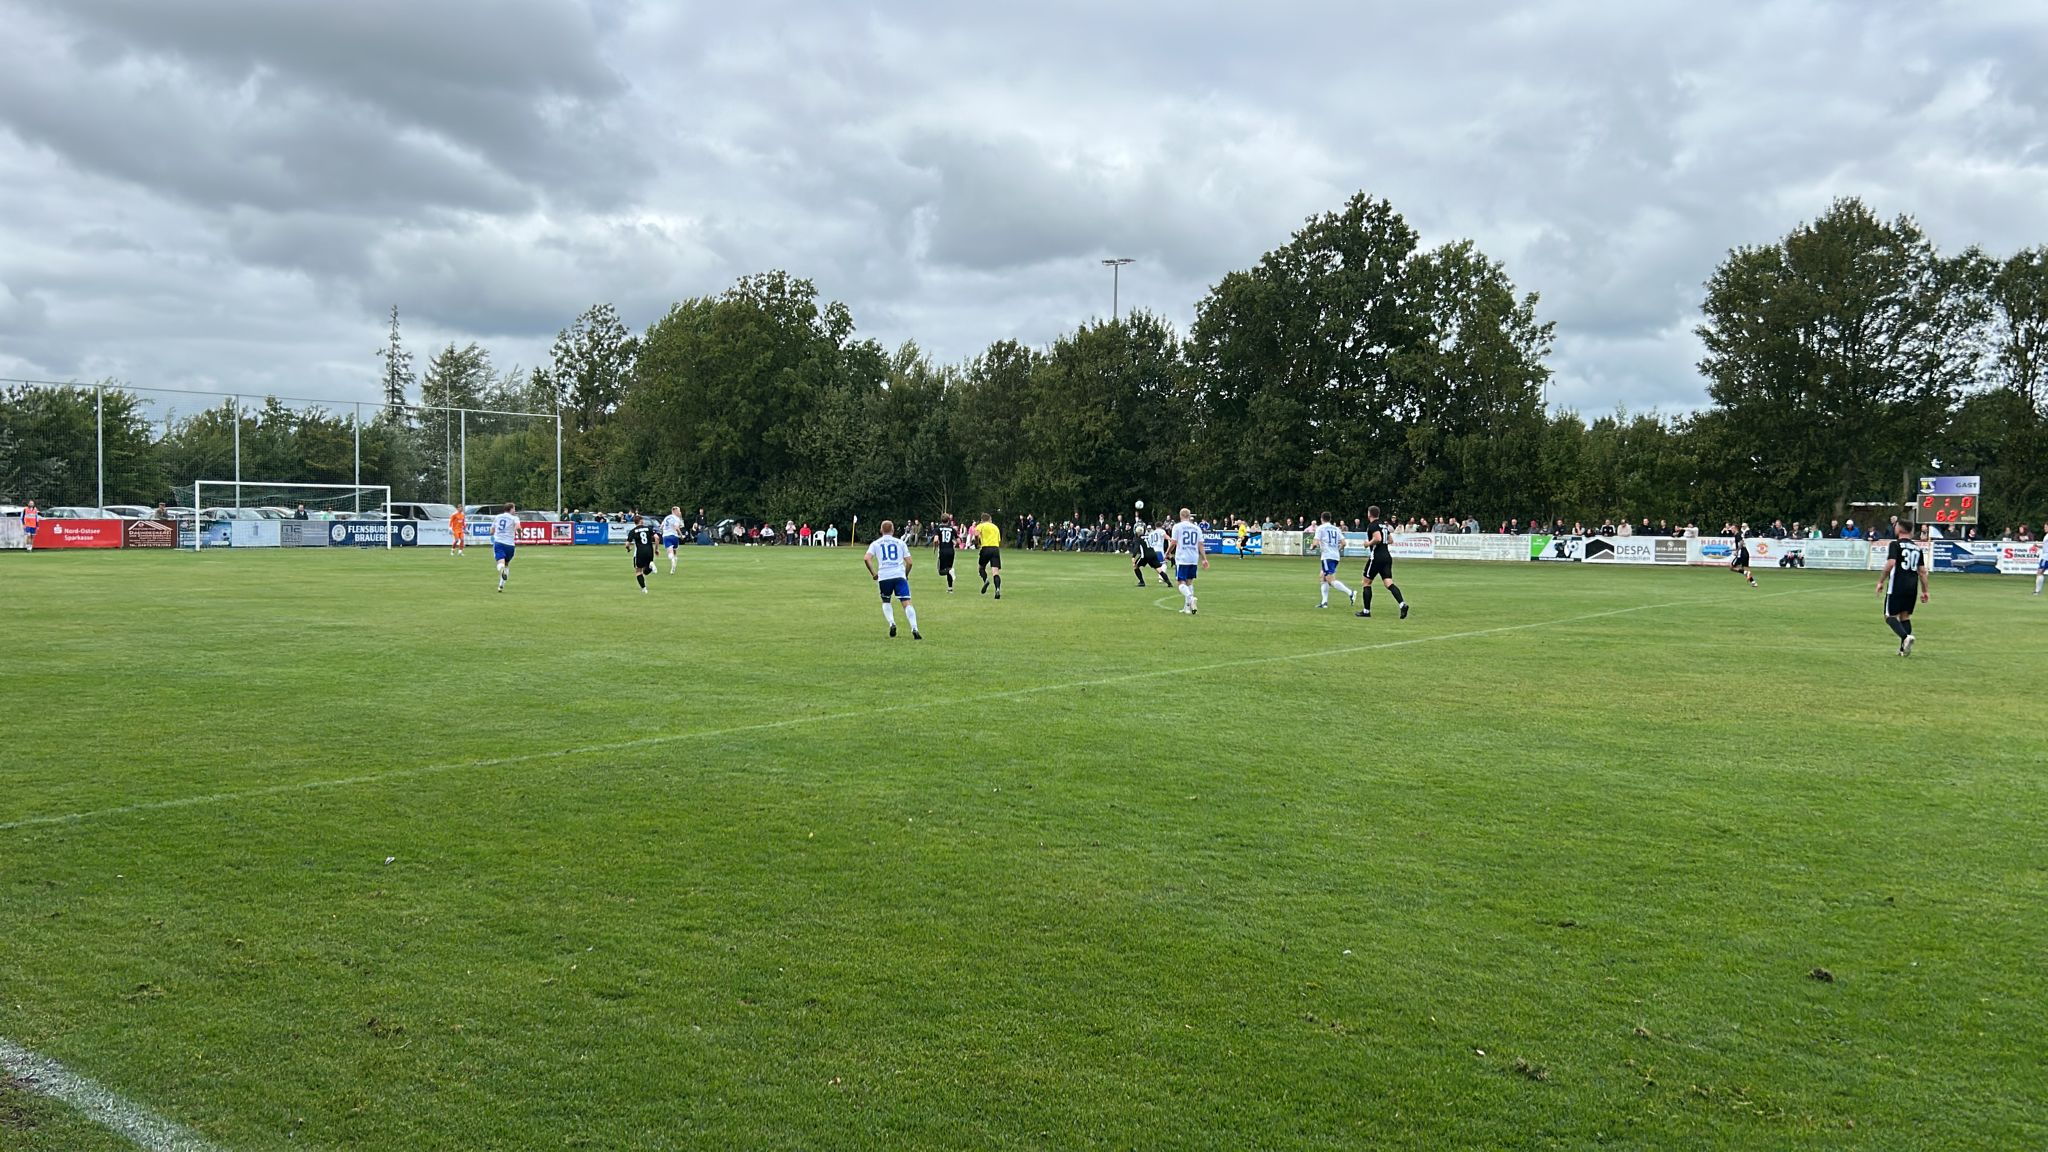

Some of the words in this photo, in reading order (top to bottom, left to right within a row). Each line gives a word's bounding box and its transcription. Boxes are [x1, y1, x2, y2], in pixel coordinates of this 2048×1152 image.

[1923, 496, 1934, 508] 2
[1961, 496, 1974, 508] 0
[348, 525, 399, 533] FLENSBURGER
[498, 519, 506, 531] 9
[354, 533, 389, 541] BRAUERE
[639, 531, 649, 545] 8
[941, 530, 952, 543] 19
[1182, 530, 1198, 545] 20
[1327, 530, 1337, 544] 14
[1434, 535, 1459, 545] FINN
[880, 543, 898, 561] 18
[1616, 545, 1651, 555] DESPA
[1901, 548, 1921, 572] 30
